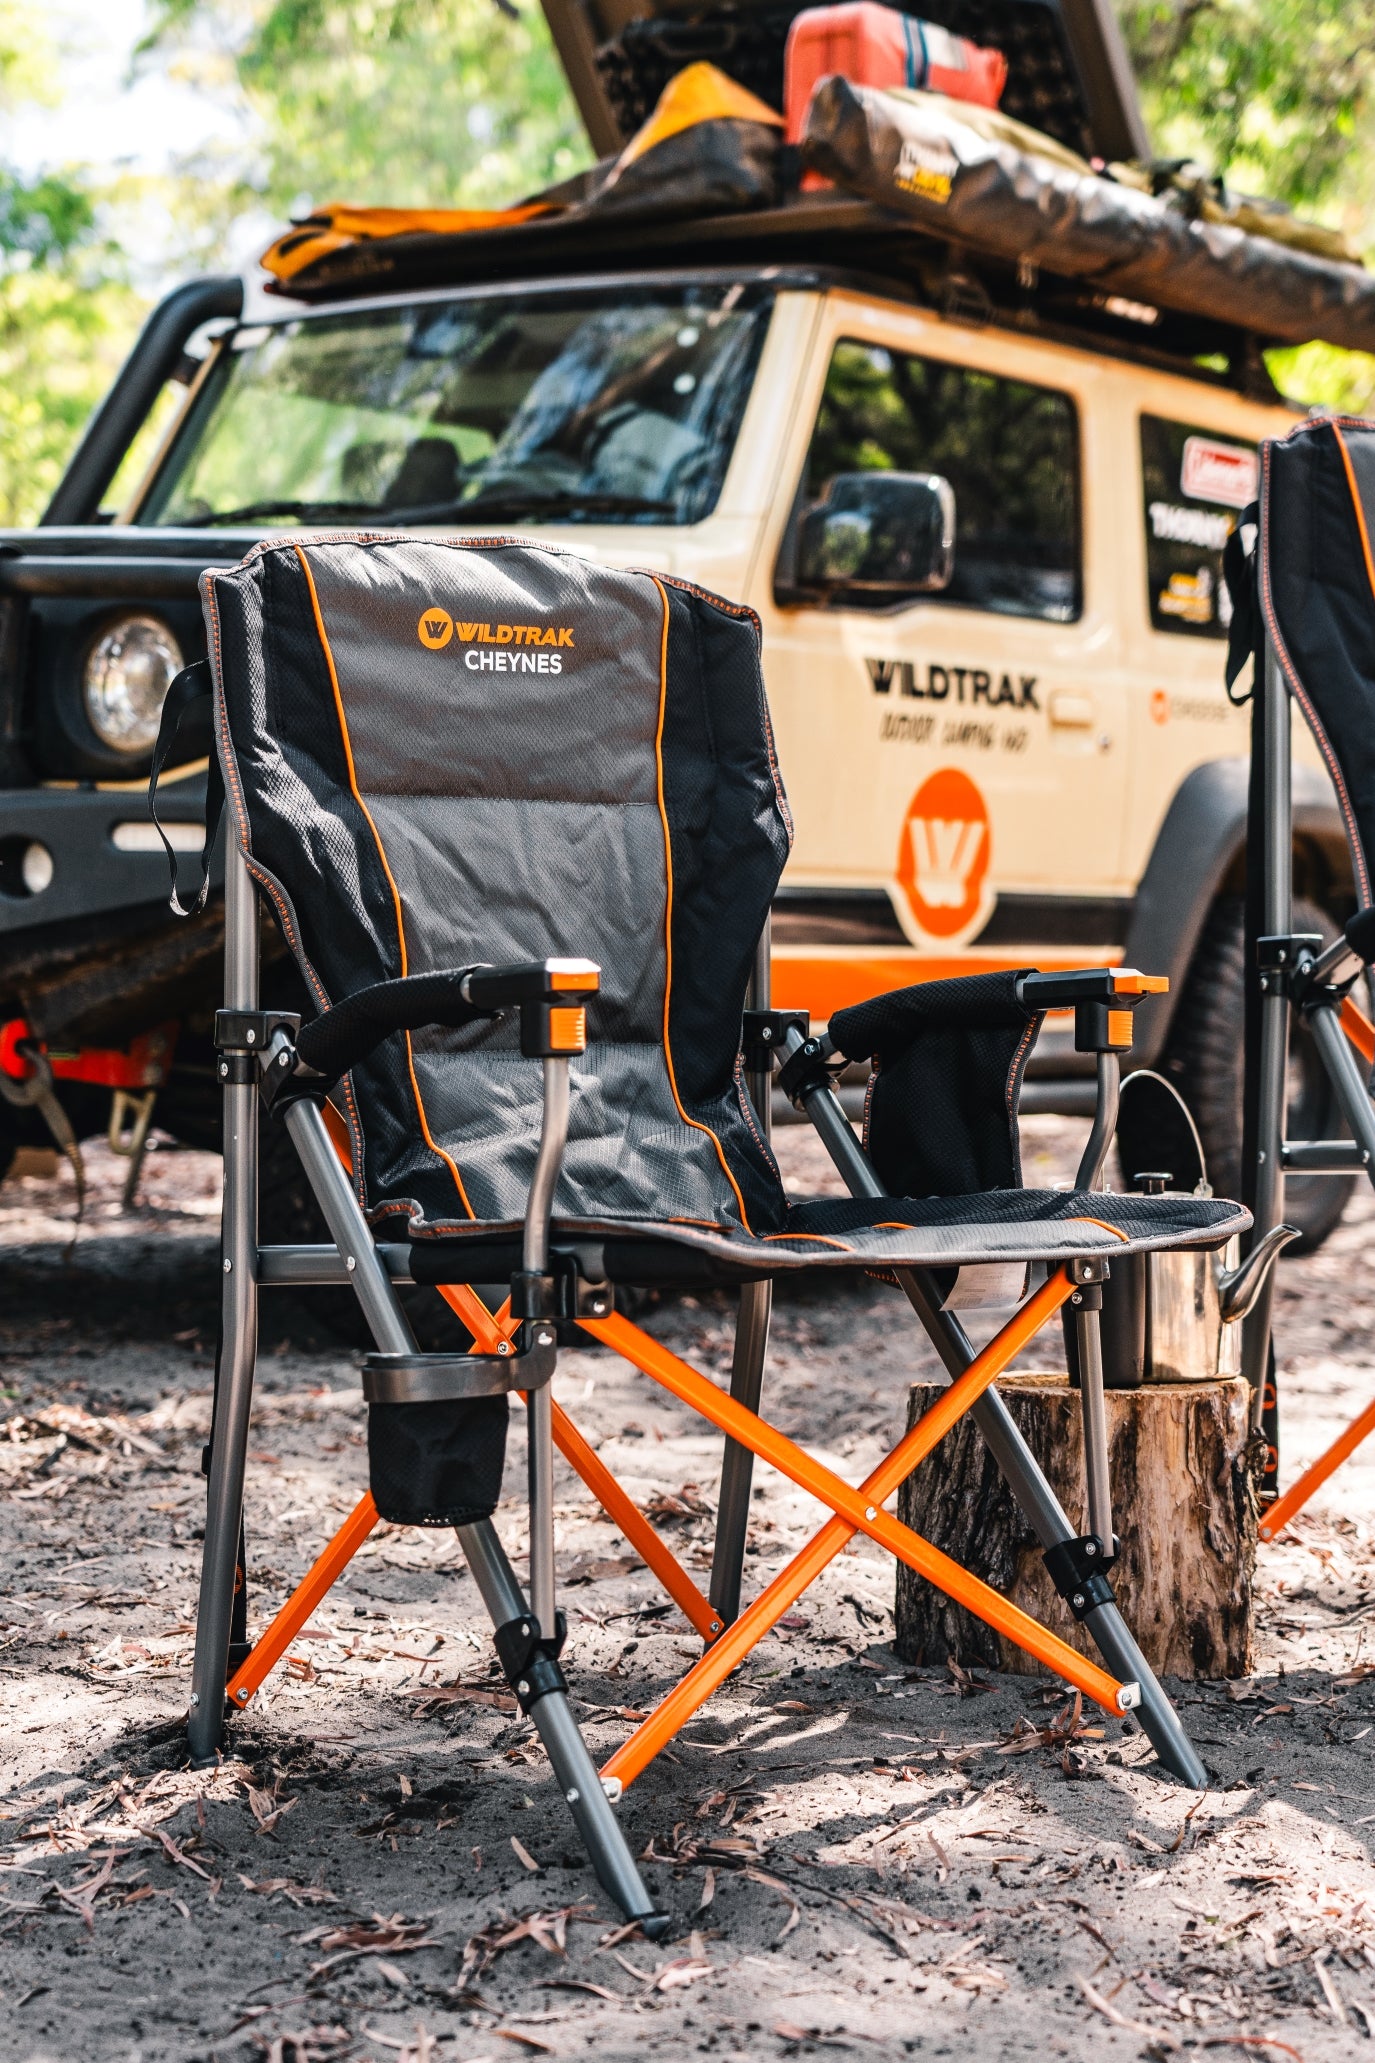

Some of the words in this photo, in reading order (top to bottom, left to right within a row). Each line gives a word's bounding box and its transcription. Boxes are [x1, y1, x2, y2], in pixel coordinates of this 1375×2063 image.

[455, 621, 575, 648] WILDTRAK
[464, 650, 563, 674] CHEYNES
[864, 657, 1041, 713] WILDTRAK
